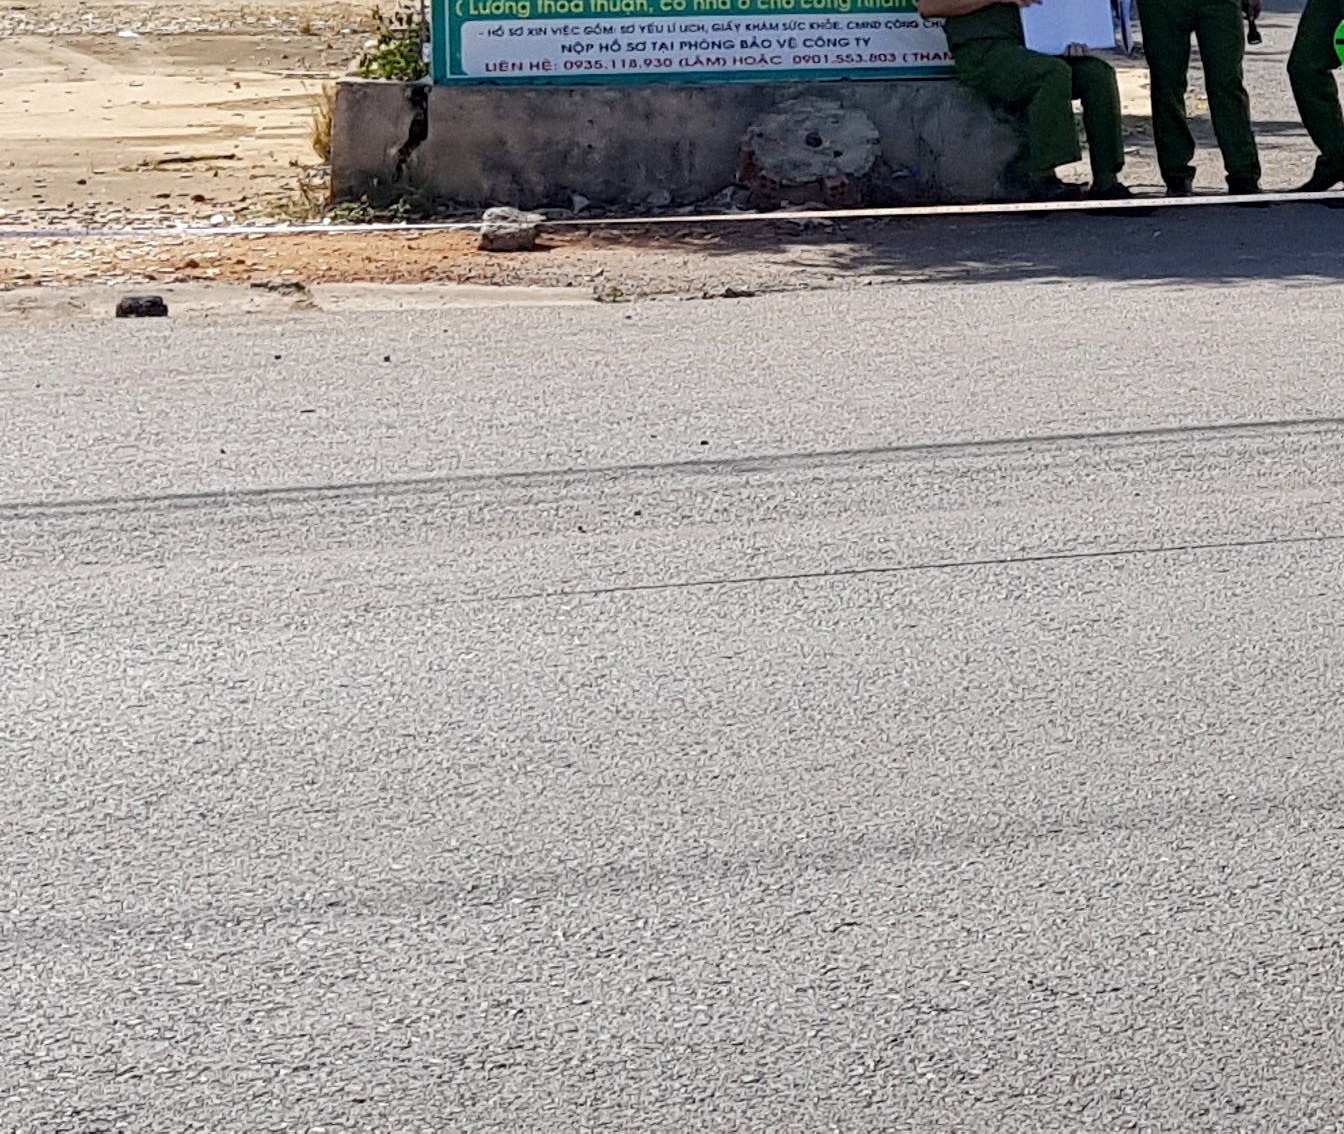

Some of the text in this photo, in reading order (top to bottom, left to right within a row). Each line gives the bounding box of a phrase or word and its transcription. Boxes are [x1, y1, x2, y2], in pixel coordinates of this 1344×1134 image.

[561, 41, 594, 54] NỘP
[600, 39, 621, 53] HỒ
[627, 40, 647, 52] SƠ
[652, 41, 674, 55] TẠI
[680, 38, 735, 51] PHÒNG
[740, 35, 771, 49] BẢO
[803, 35, 849, 48] CÔNG
[854, 36, 871, 47] TY
[485, 59, 523, 72] LIÊN
